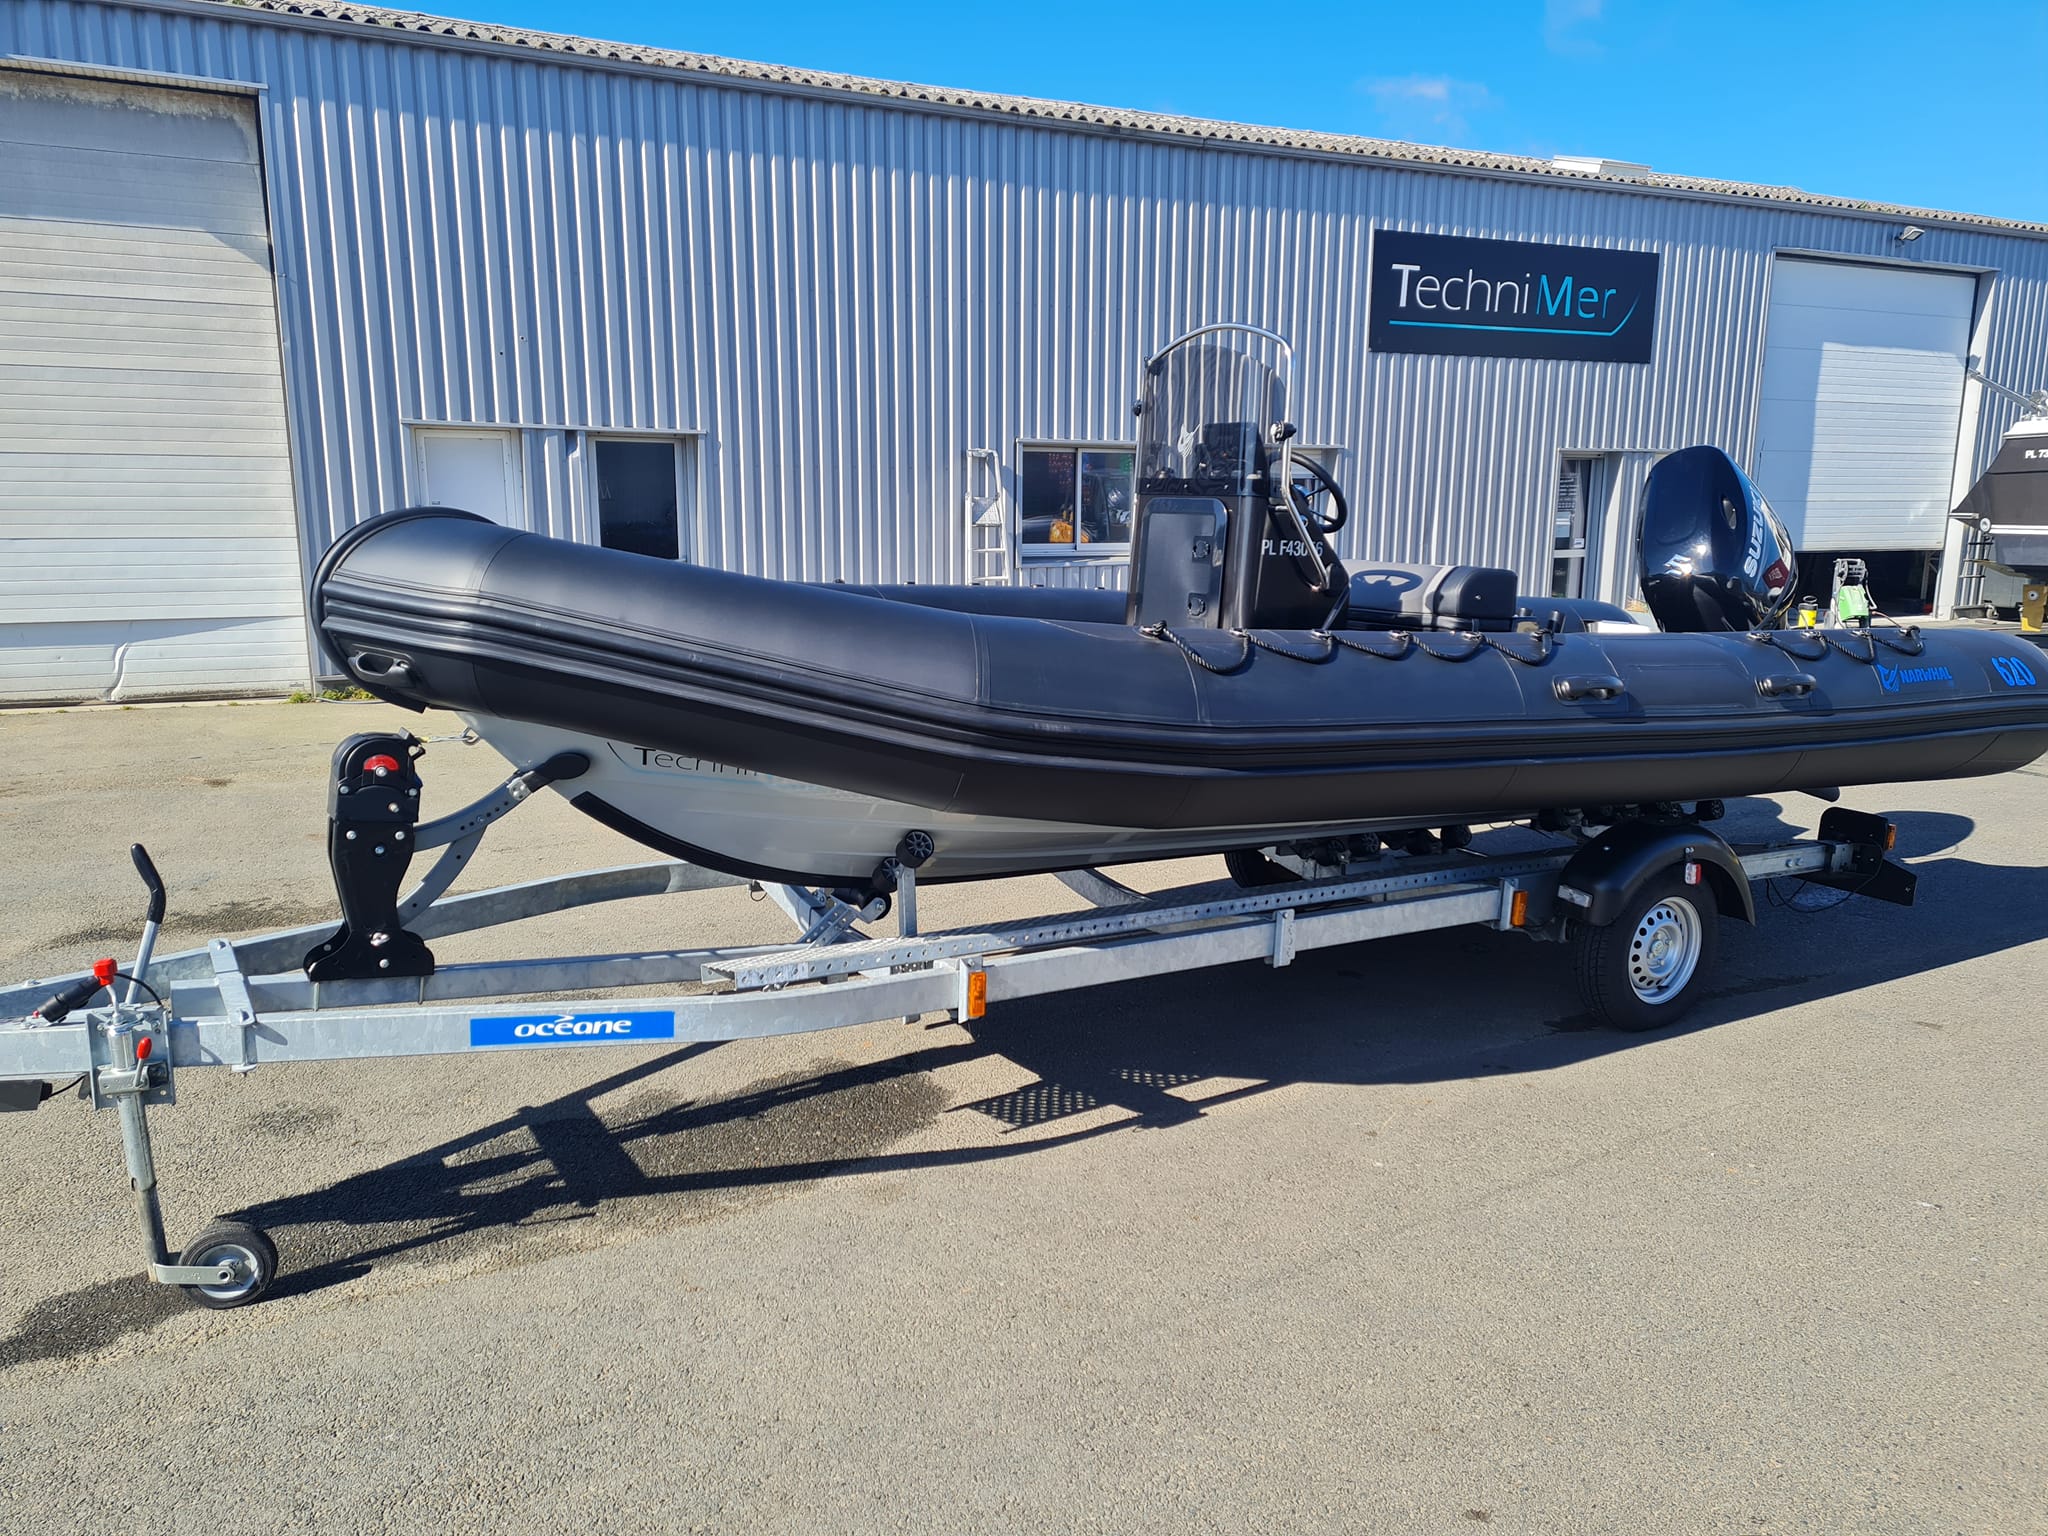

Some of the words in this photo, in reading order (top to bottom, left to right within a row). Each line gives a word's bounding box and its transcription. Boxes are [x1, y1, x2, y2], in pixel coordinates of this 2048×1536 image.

[2025, 449, 2038, 459] PL
[1262, 539, 1277, 556] PL
[1280, 540, 1324, 557] F4306
[1900, 666, 1952, 684] NARWHAL
[1991, 656, 2037, 687] 620
[514, 1014, 632, 1038] océane
